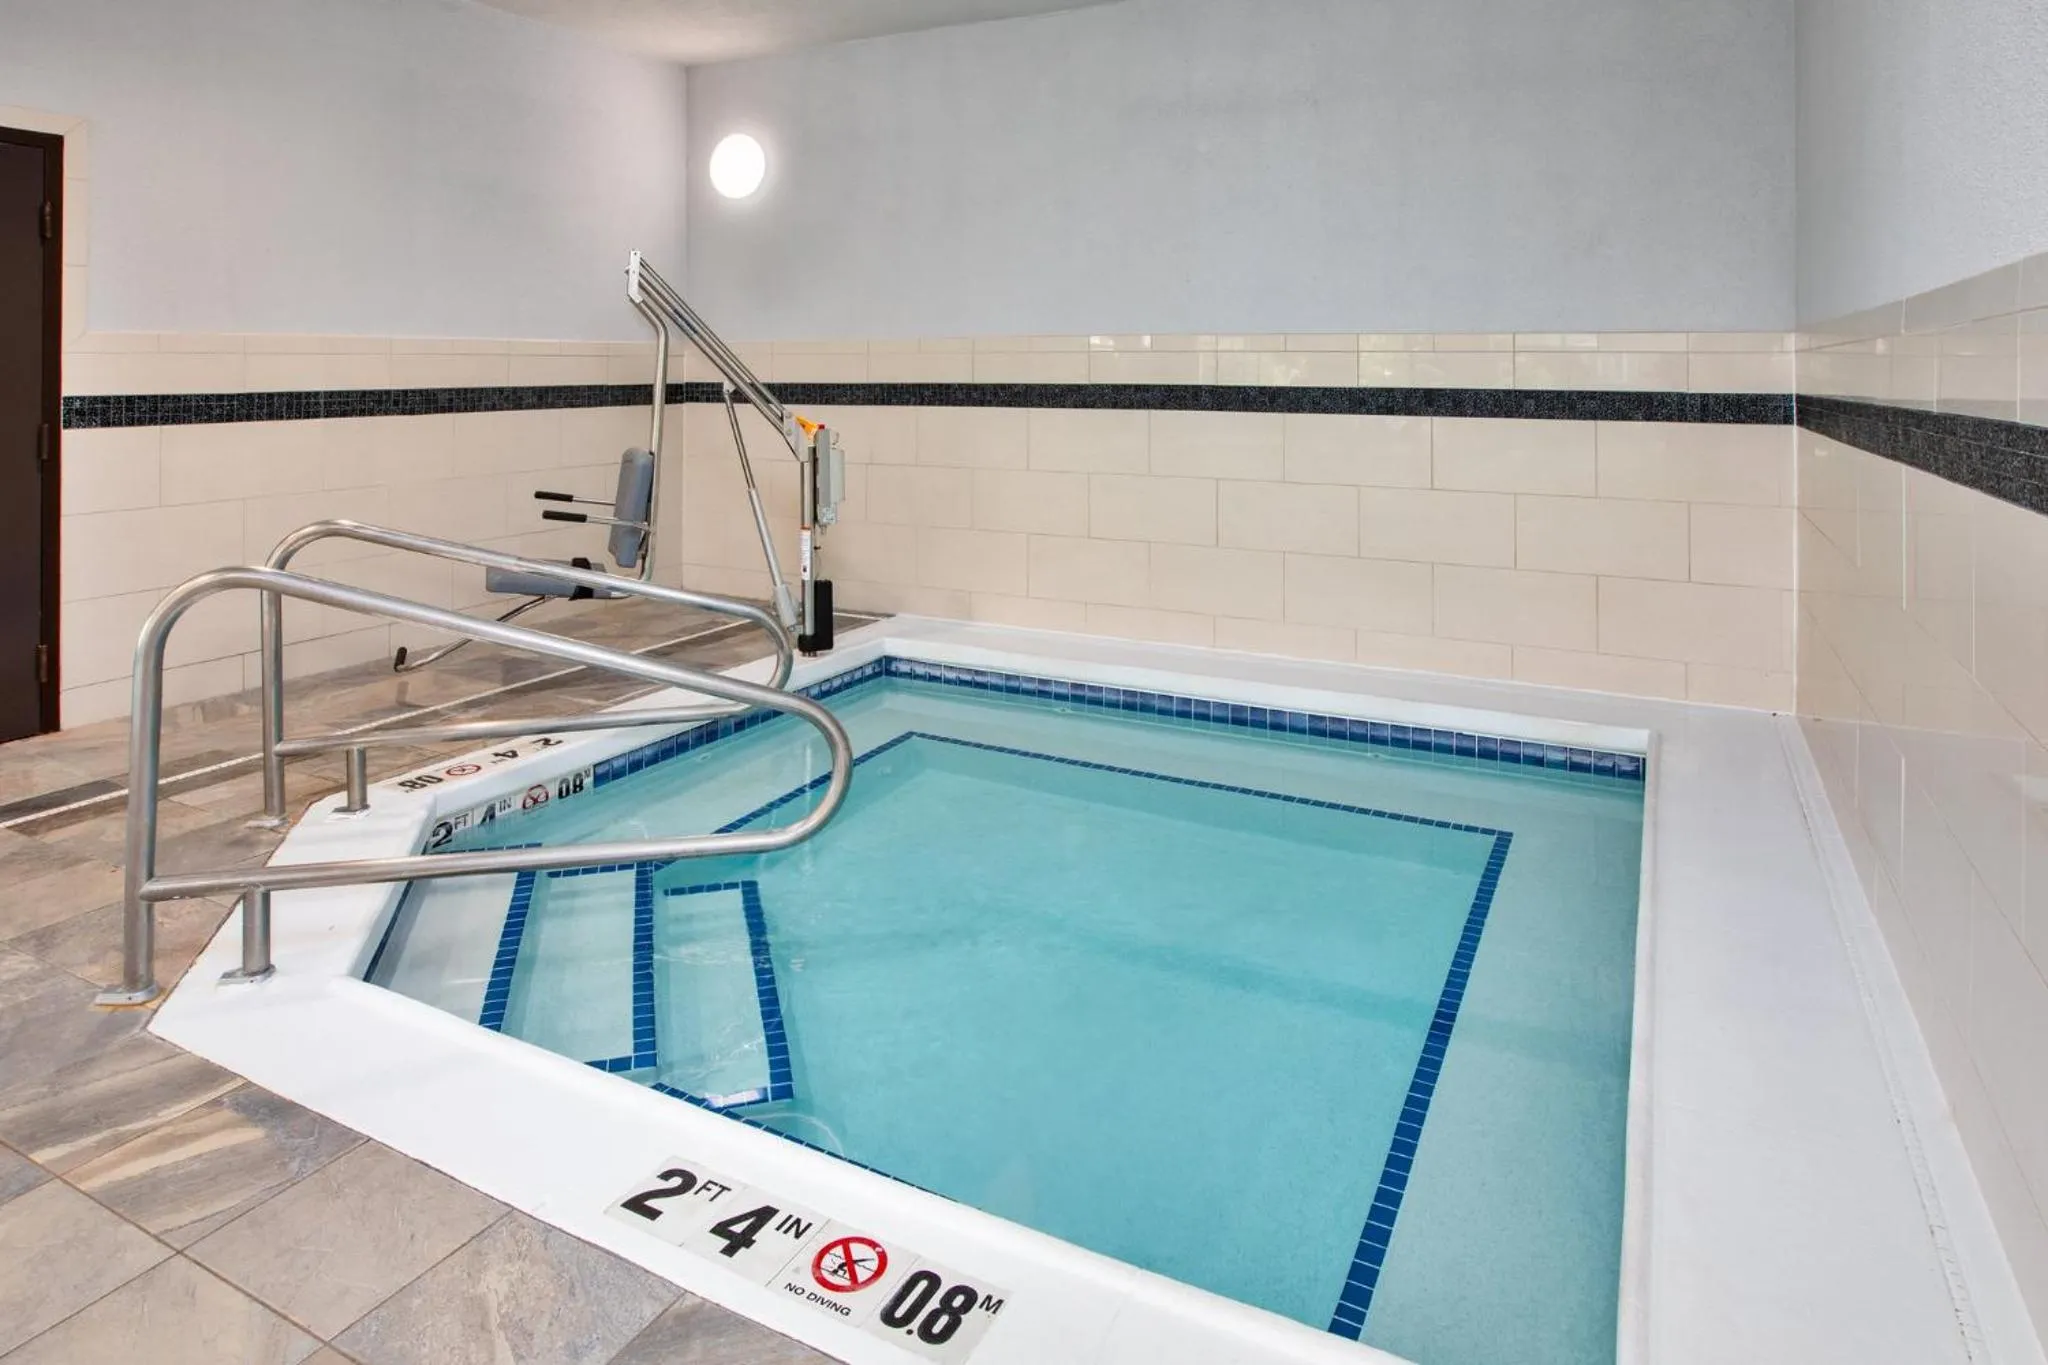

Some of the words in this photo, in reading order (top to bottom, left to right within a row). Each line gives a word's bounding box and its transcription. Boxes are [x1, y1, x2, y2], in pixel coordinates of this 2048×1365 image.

[432, 821, 453, 849] 2
[454, 813, 469, 830] FT
[499, 797, 512, 812] IN
[619, 1168, 697, 1221] 2
[695, 1180, 732, 1204] FT
[709, 1205, 780, 1258] 4
[774, 1213, 815, 1240] IN
[784, 1282, 805, 1296] NO
[806, 1291, 852, 1317] DIVING
[880, 1270, 978, 1345] 0.8
[978, 1294, 1004, 1314] M
